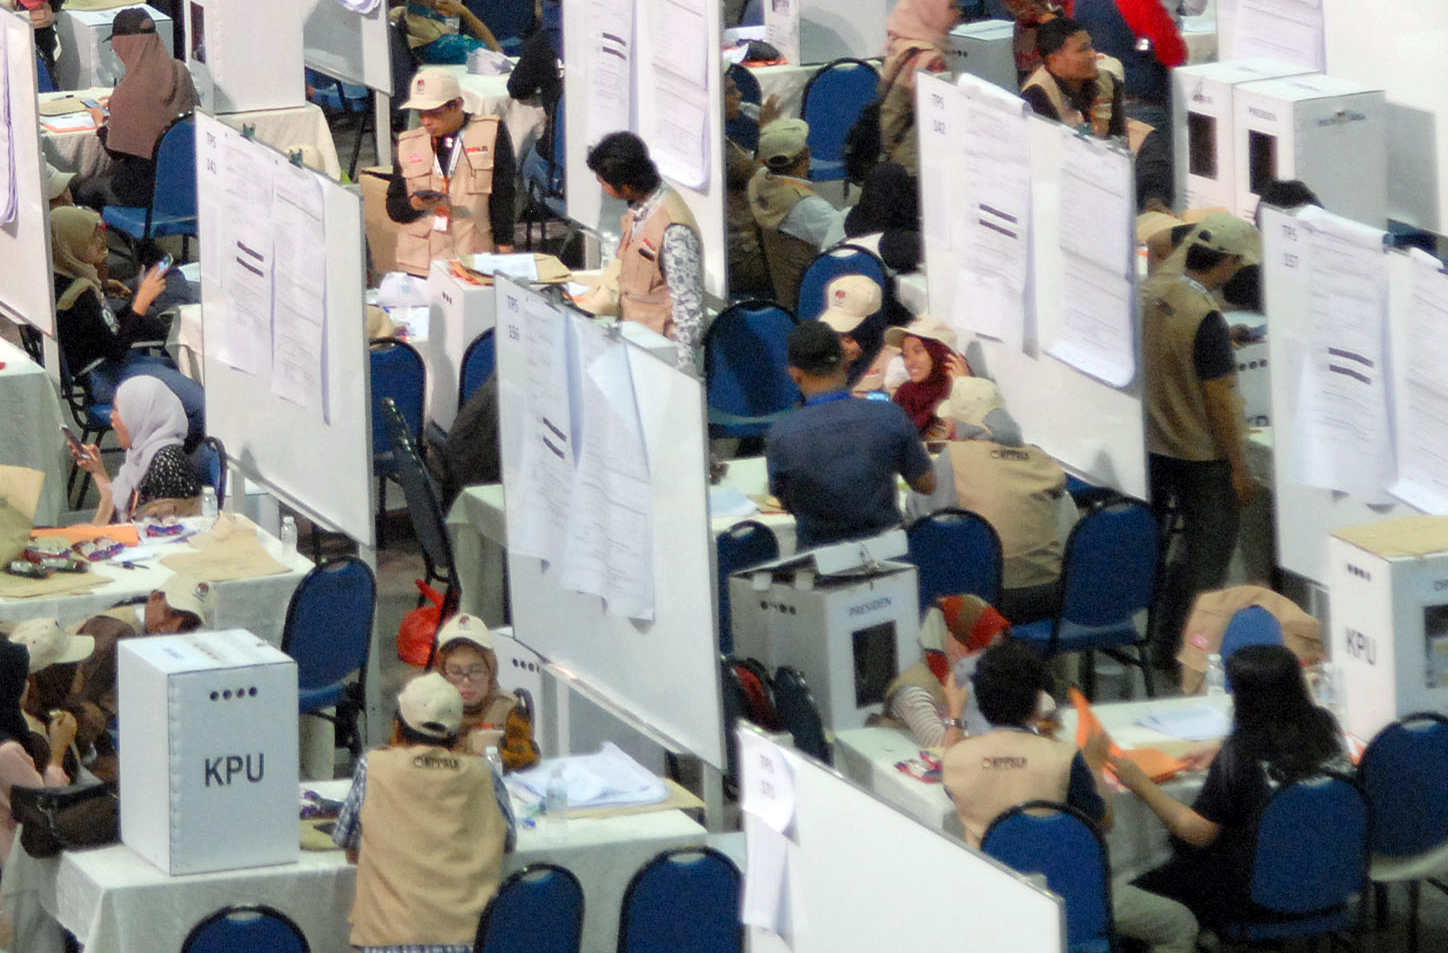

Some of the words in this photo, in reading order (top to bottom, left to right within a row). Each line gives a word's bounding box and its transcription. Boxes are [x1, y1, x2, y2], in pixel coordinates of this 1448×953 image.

[205, 131, 217, 150] TPS
[505, 294, 520, 314] TPS
[1345, 626, 1378, 669] KPU
[204, 751, 266, 789] KPU
